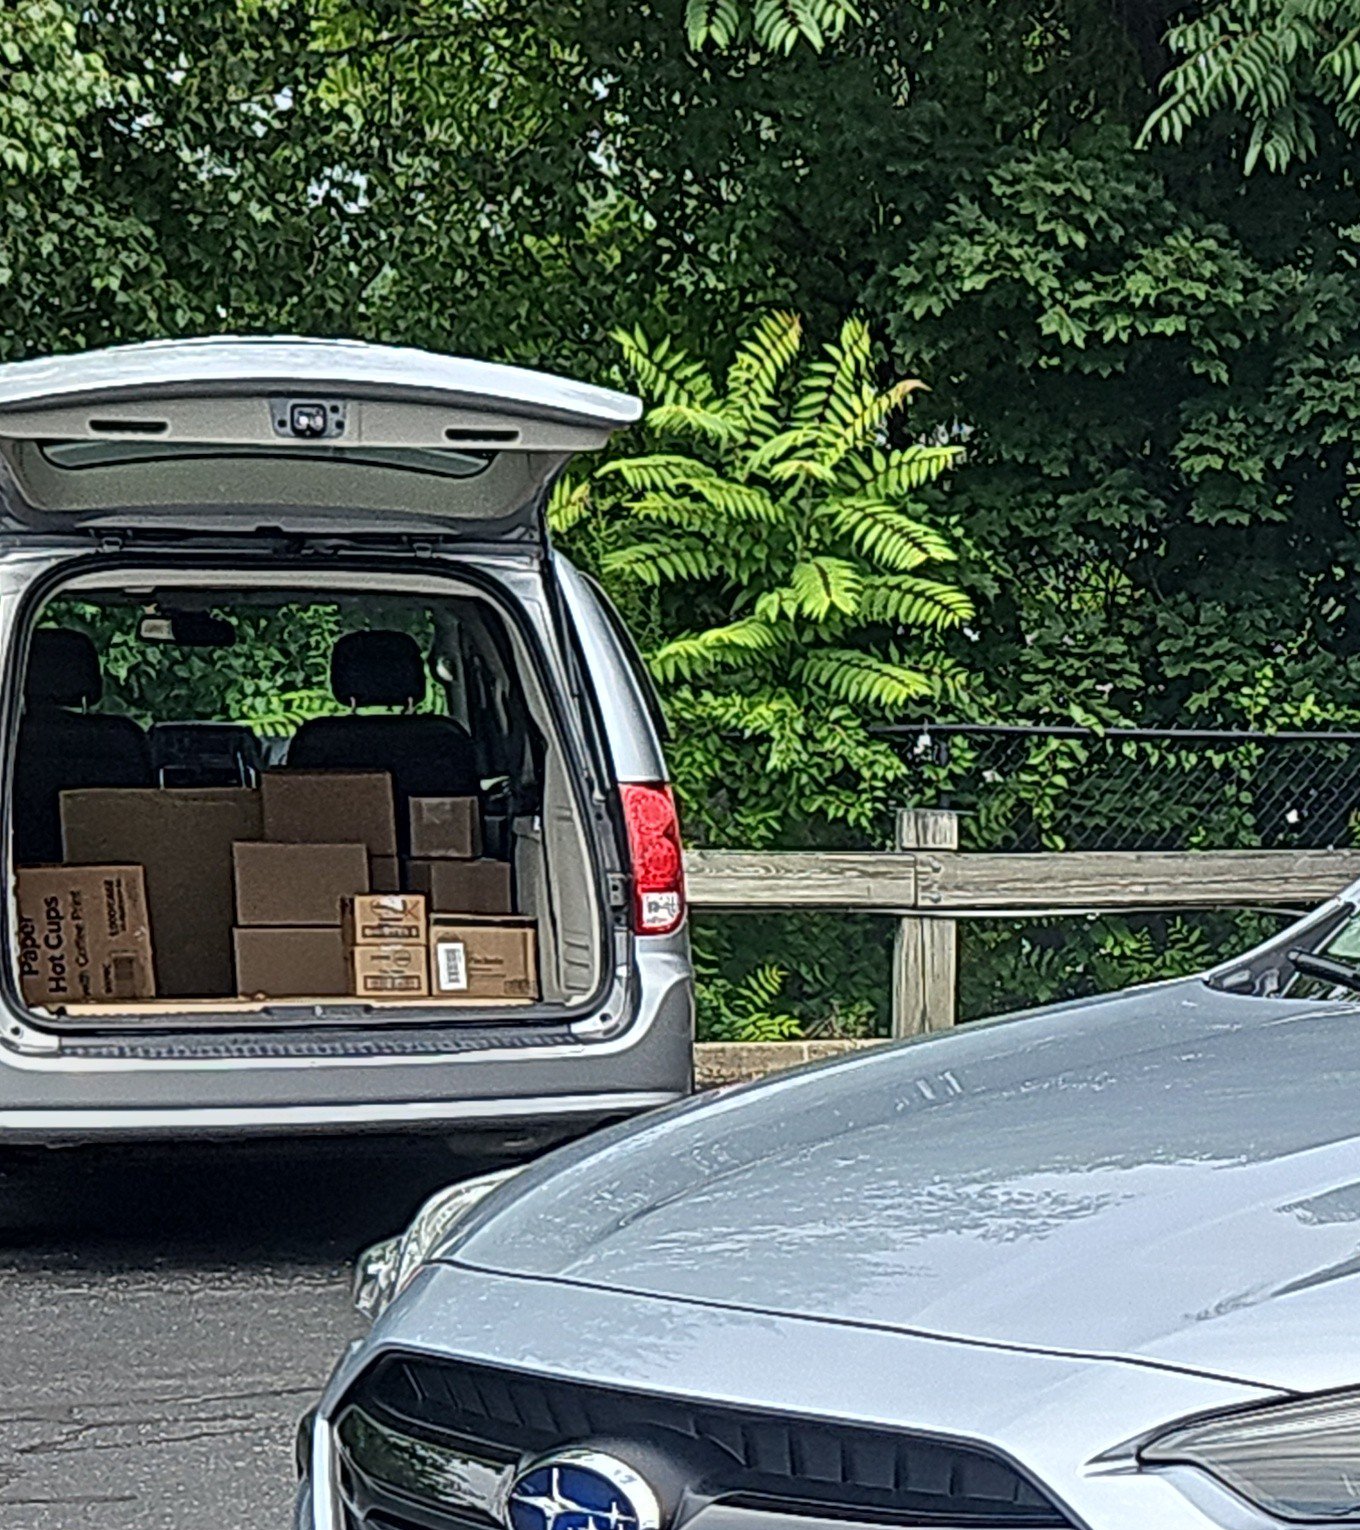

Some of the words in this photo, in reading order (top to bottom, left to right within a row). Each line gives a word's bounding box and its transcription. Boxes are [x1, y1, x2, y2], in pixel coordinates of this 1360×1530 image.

[20, 915, 40, 976] Paper
[44, 896, 64, 950] Cups
[47, 954, 67, 993] Hot
